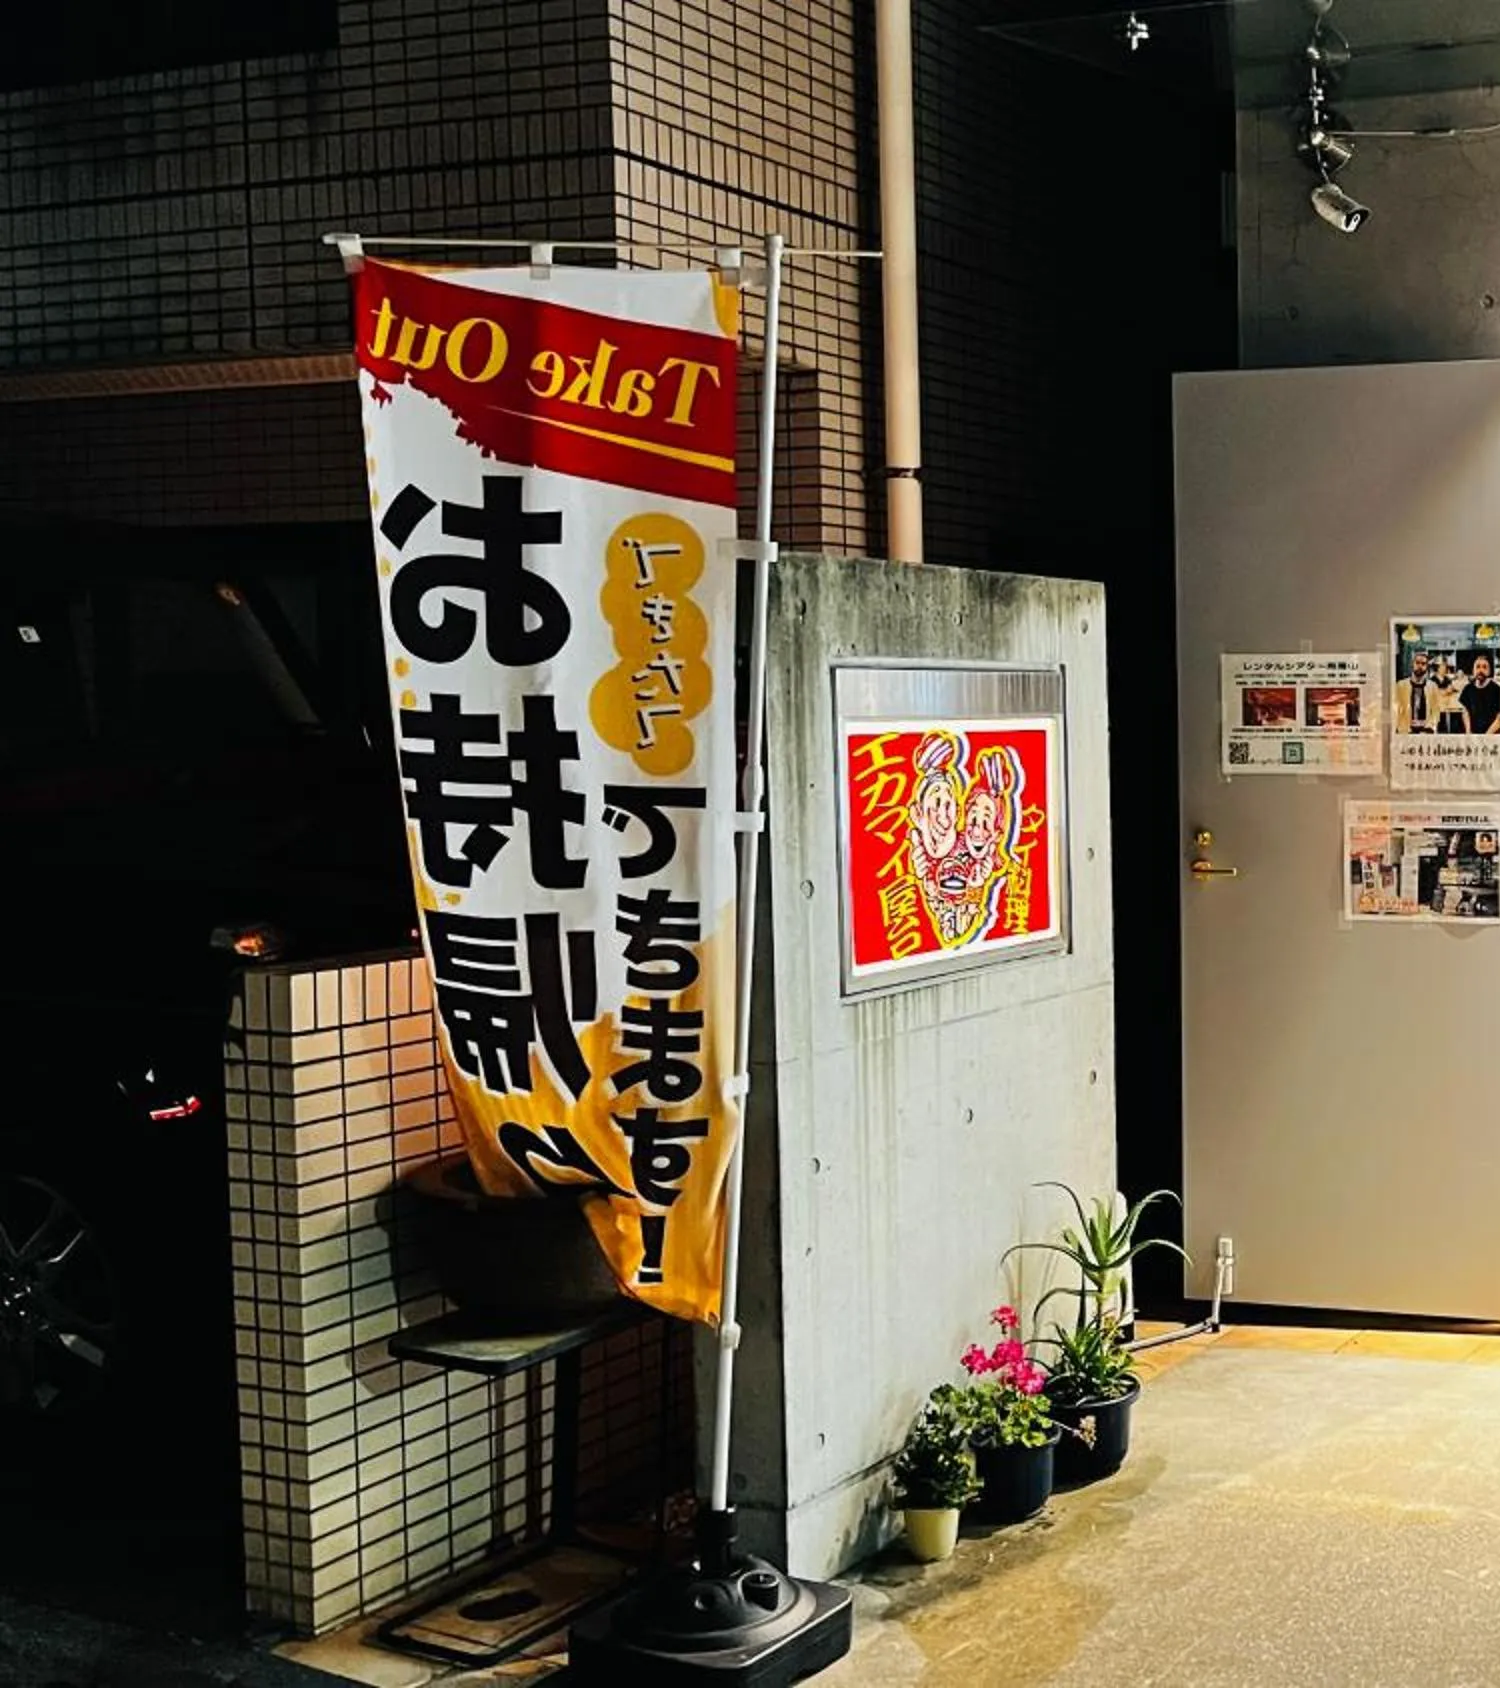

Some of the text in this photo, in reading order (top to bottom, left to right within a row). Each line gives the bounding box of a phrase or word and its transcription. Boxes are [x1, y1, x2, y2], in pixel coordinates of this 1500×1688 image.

[853, 732, 924, 961] エカマイ屋台
[1004, 803, 1046, 937] タイ料理
